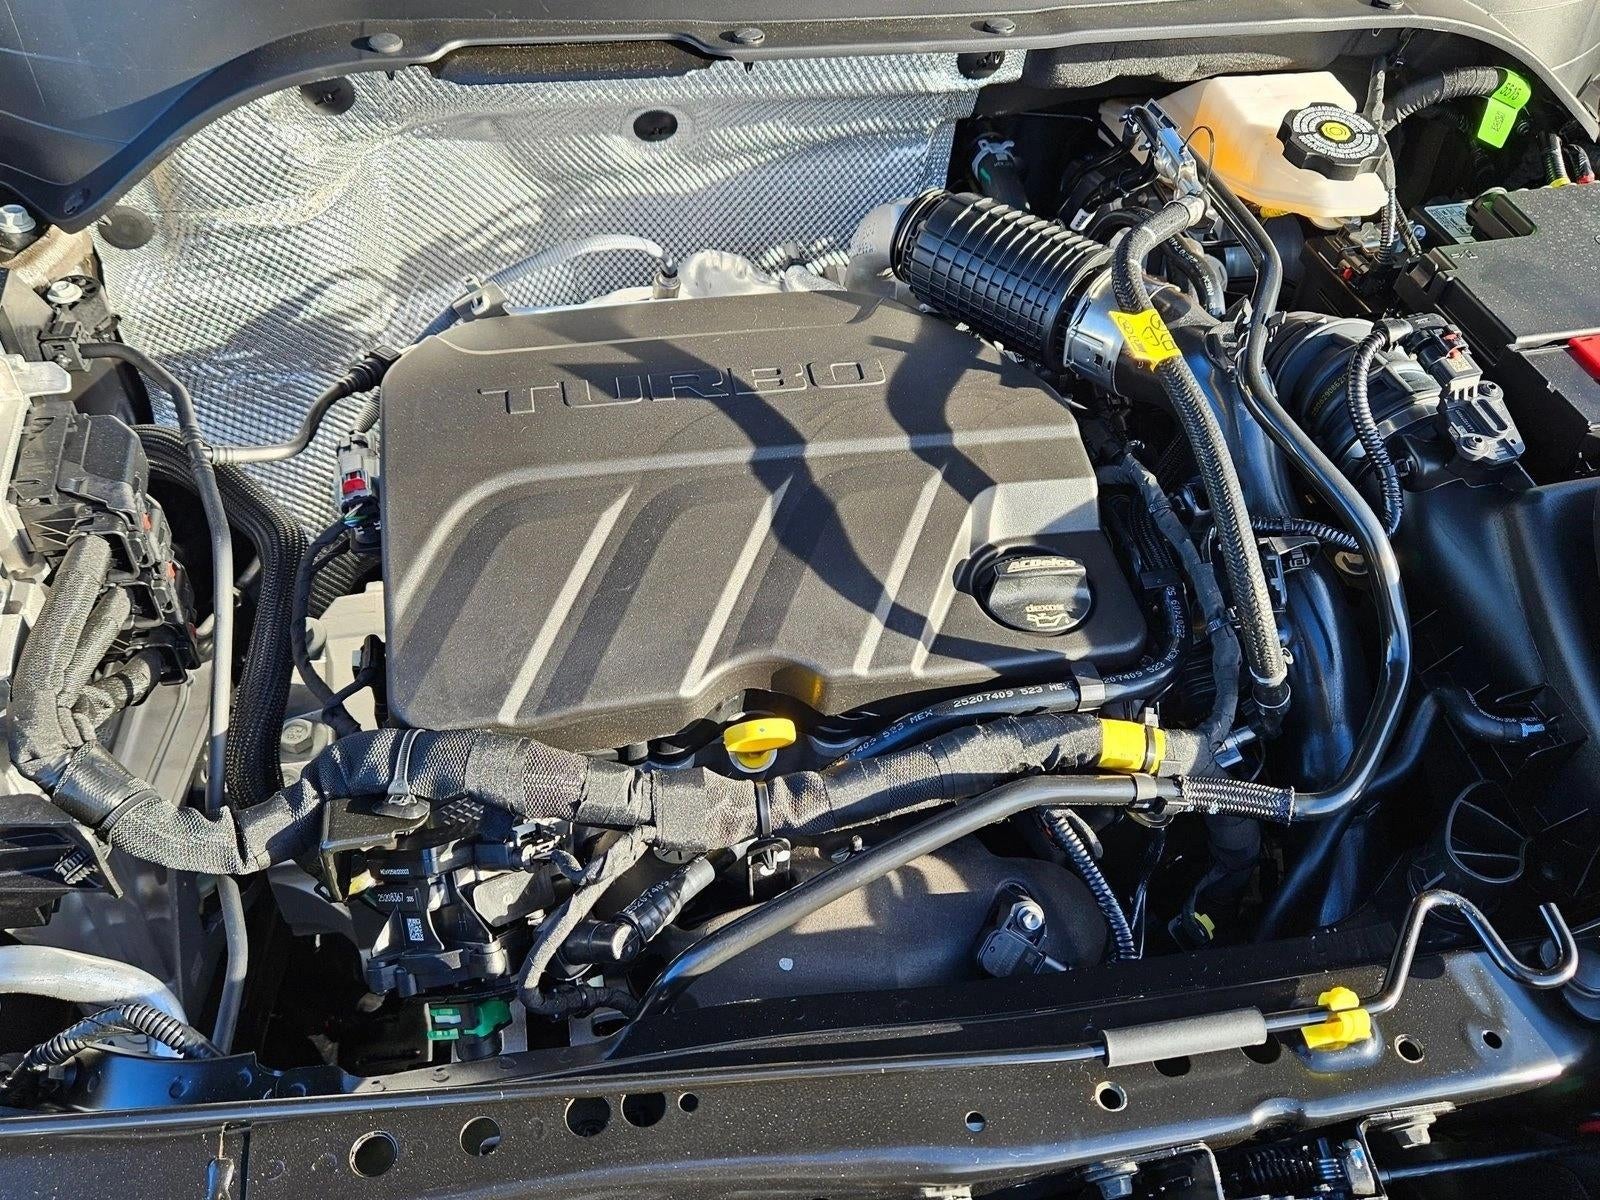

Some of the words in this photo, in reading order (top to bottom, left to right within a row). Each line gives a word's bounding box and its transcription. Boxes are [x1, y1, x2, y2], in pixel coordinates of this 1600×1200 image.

[477, 360, 886, 415] TURBO
[953, 690, 1014, 708] 25207409
[1020, 686, 1043, 695] 523
[1049, 682, 1071, 691] MEX
[1102, 670, 1143, 684] 207409
[843, 738, 877, 760] 07409
[909, 709, 934, 724] MEX
